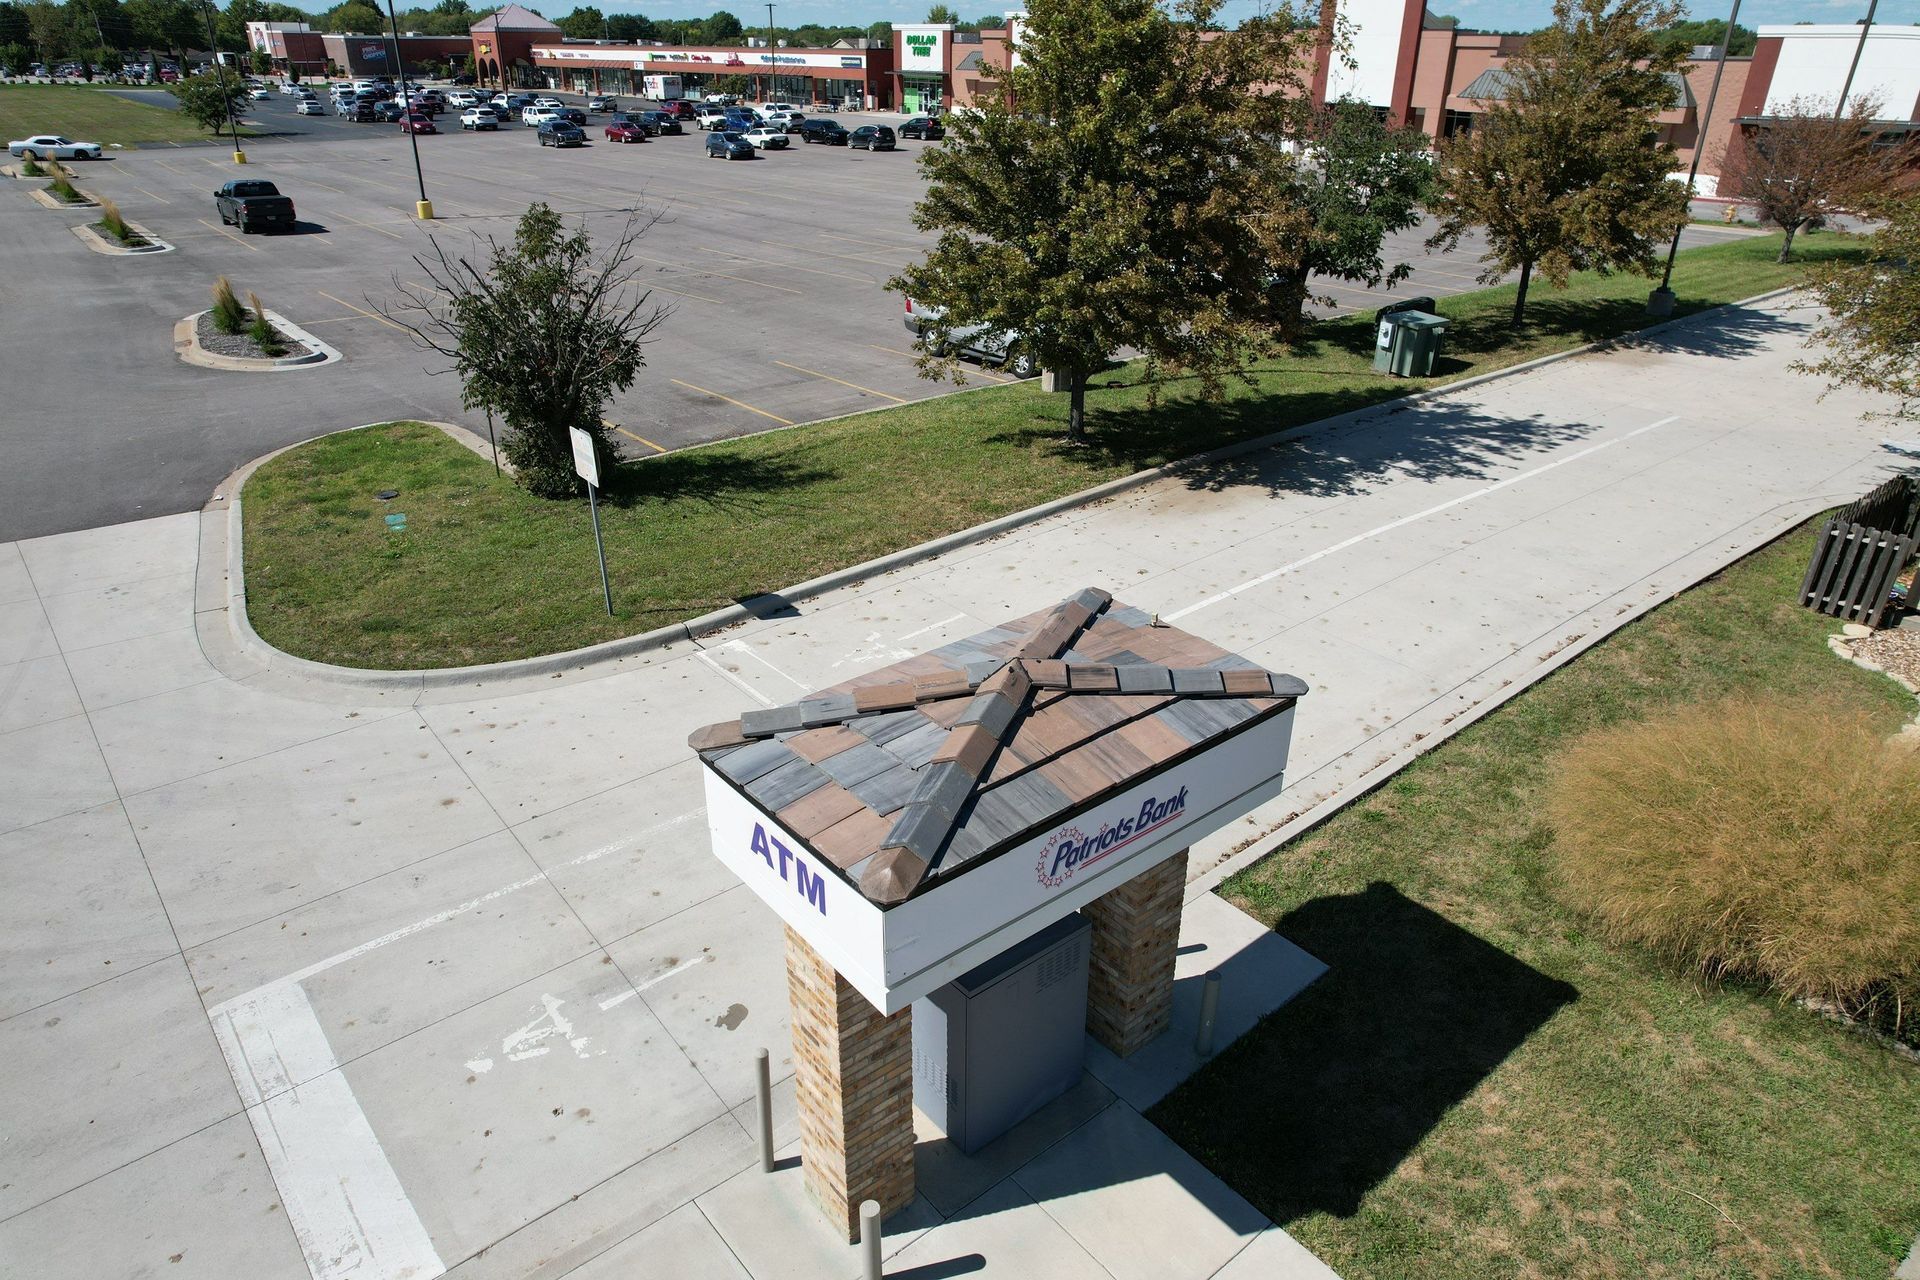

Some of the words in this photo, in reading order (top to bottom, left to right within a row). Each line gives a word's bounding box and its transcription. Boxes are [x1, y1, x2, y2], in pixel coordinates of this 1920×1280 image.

[906, 35, 937, 46] DOLLAR
[912, 46, 931, 57] TREE
[1050, 816, 1135, 877] Patriots
[1134, 784, 1189, 833] Bank
[750, 821, 827, 917] ATM
